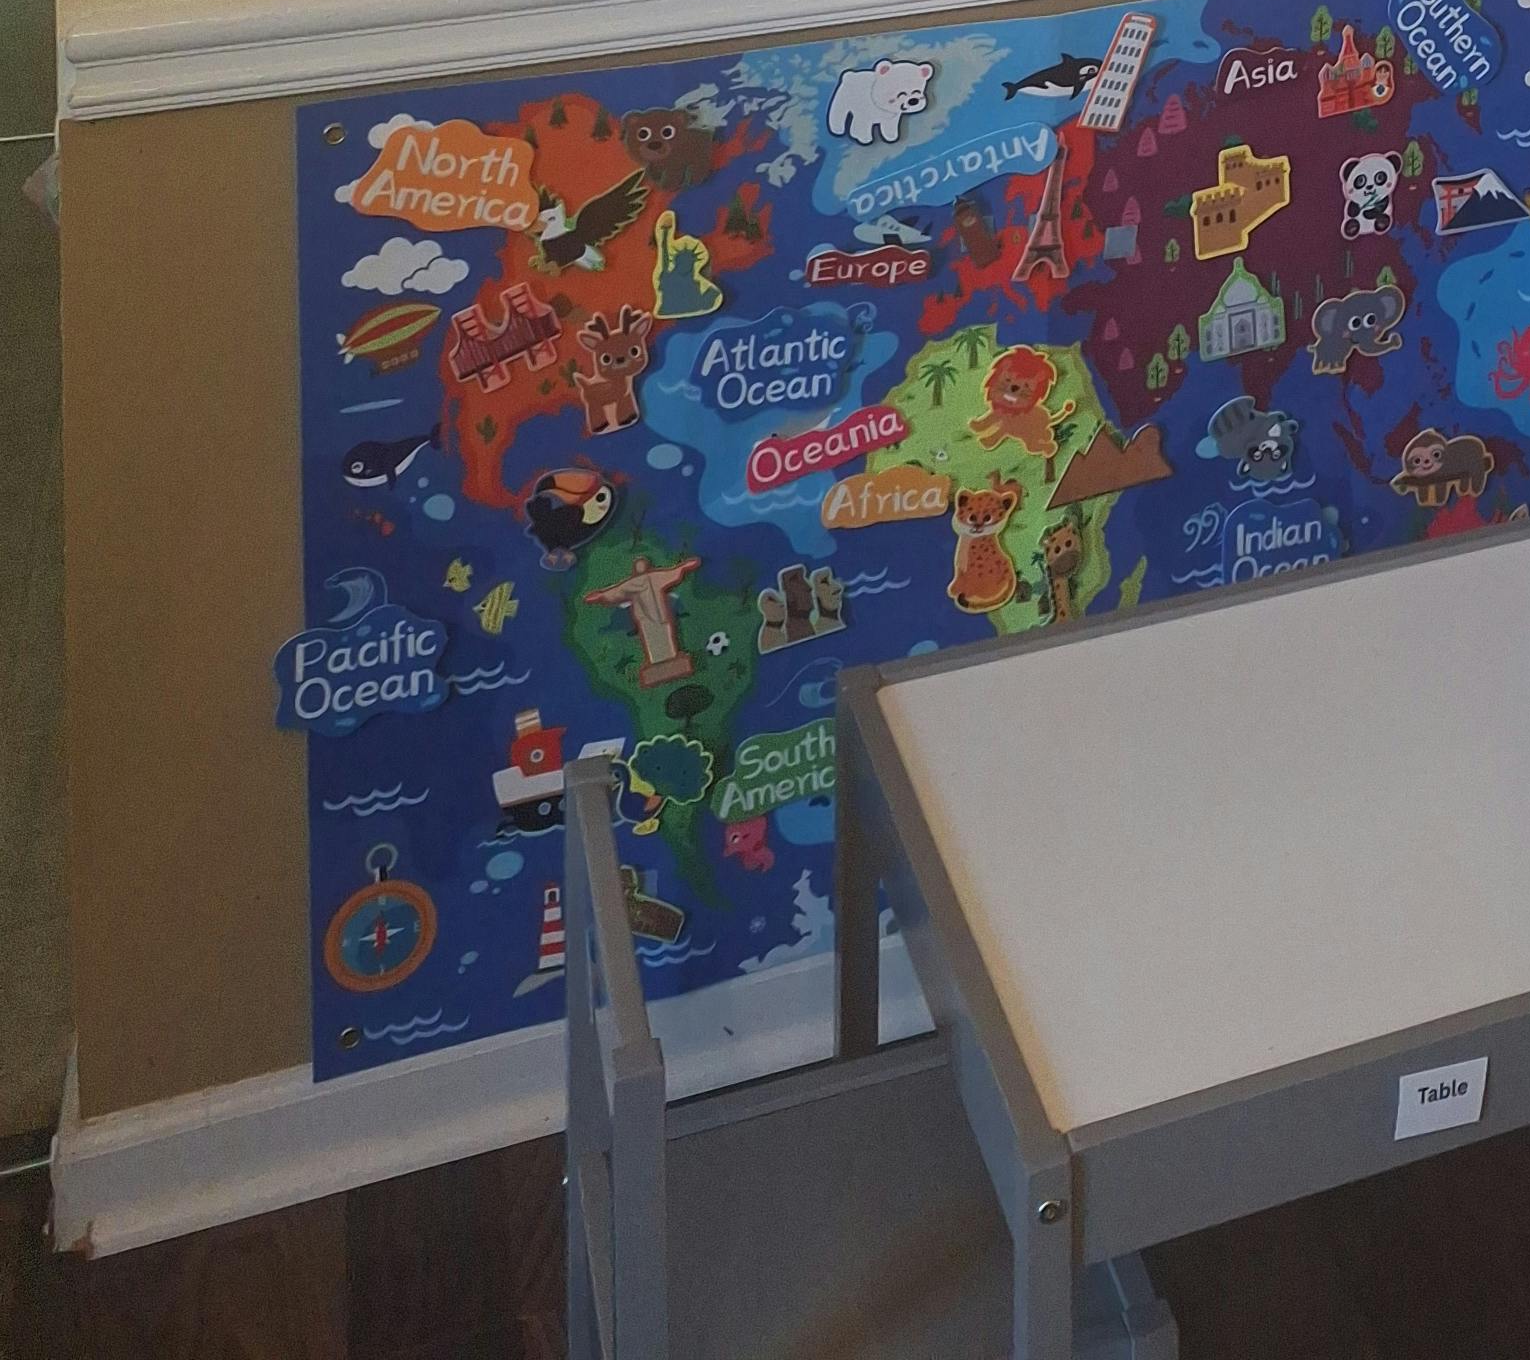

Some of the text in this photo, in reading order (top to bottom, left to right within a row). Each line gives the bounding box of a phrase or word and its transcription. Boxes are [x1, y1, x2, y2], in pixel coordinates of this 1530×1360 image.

[1398, 0, 1458, 90] Ocean
[1224, 58, 1298, 94] Asia
[396, 135, 520, 188] North
[851, 127, 1049, 215] Antarctica
[362, 170, 531, 228] America
[812, 257, 928, 282] Europe
[702, 331, 847, 378] Atlantic
[716, 370, 833, 410] Ocean
[750, 410, 902, 483] Oceania
[827, 484, 947, 520] Africa
[1236, 516, 1323, 556] Indian
[294, 620, 437, 682] Pacific
[294, 664, 435, 719] Ocean
[738, 727, 836, 780] South
[720, 759, 836, 819] Americ
[1418, 1079, 1468, 1105] Table
